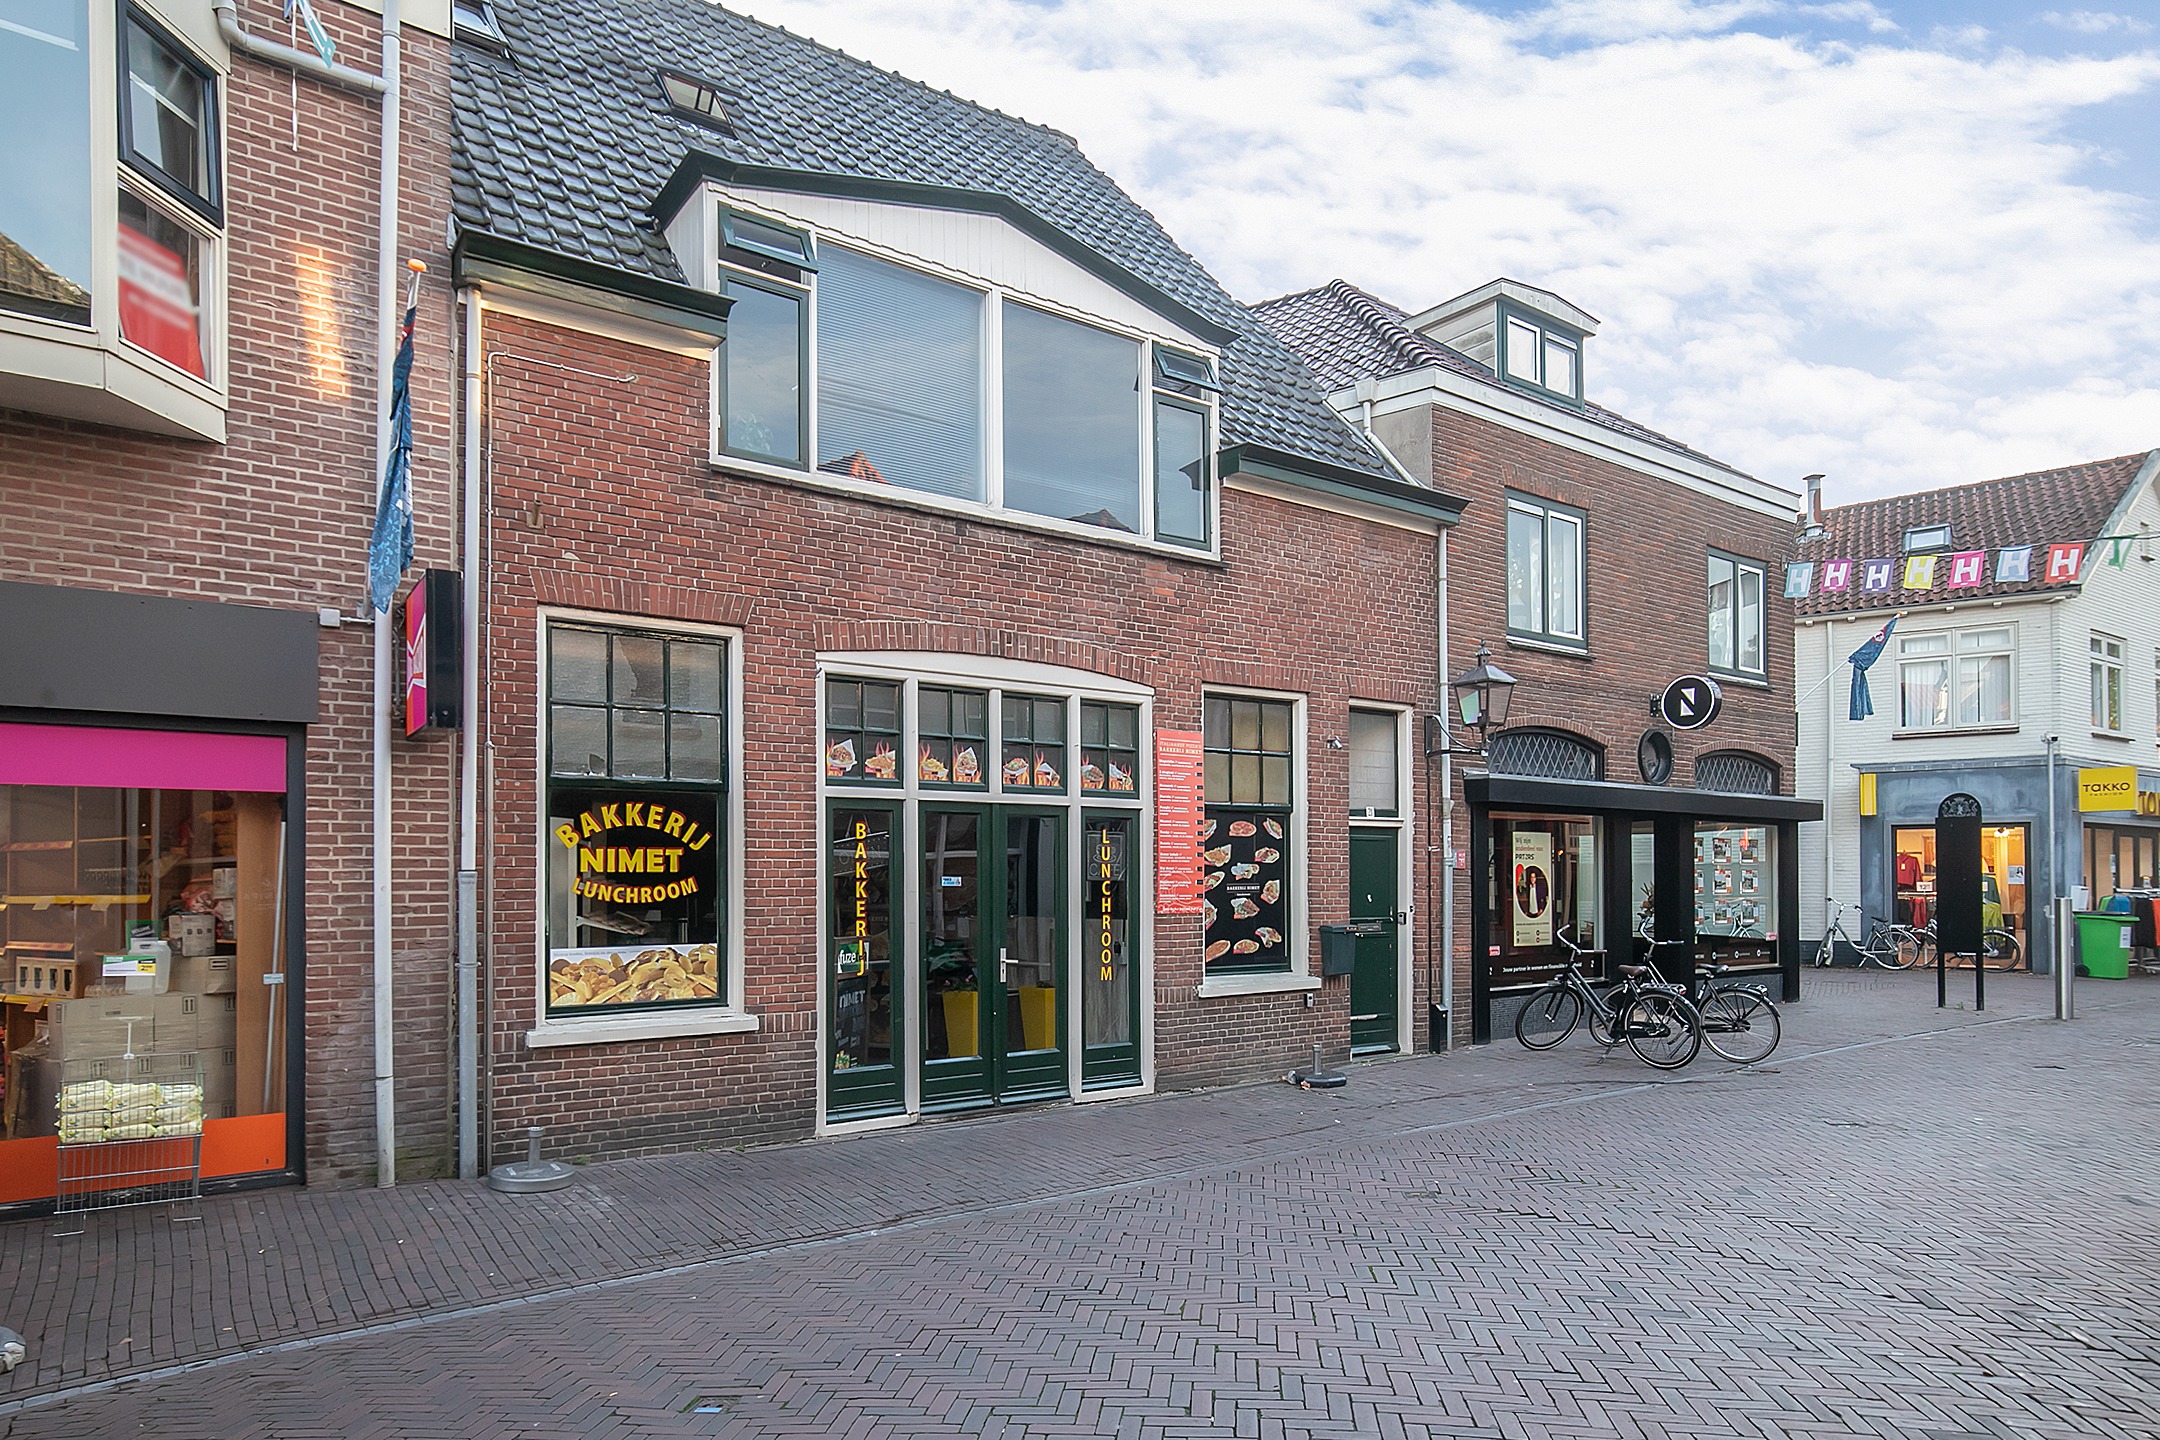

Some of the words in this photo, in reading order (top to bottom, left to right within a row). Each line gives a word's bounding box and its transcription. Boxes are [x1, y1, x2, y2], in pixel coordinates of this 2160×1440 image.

[1824, 562, 1848, 588] H
[1909, 557, 1935, 584] H
[1954, 556, 1980, 584] H
[2001, 550, 2029, 577] H
[2050, 548, 2080, 577] H
[1788, 568, 1810, 593] H
[1866, 564, 1890, 590] H
[555, 801, 713, 851] BAKKERIJ
[579, 846, 685, 873] NIMET
[571, 875, 700, 904] LUNCHROOM
[854, 821, 869, 976] BAKKERIJ
[1100, 827, 1113, 981] LUNCHROOM
[839, 949, 857, 965] fuze
